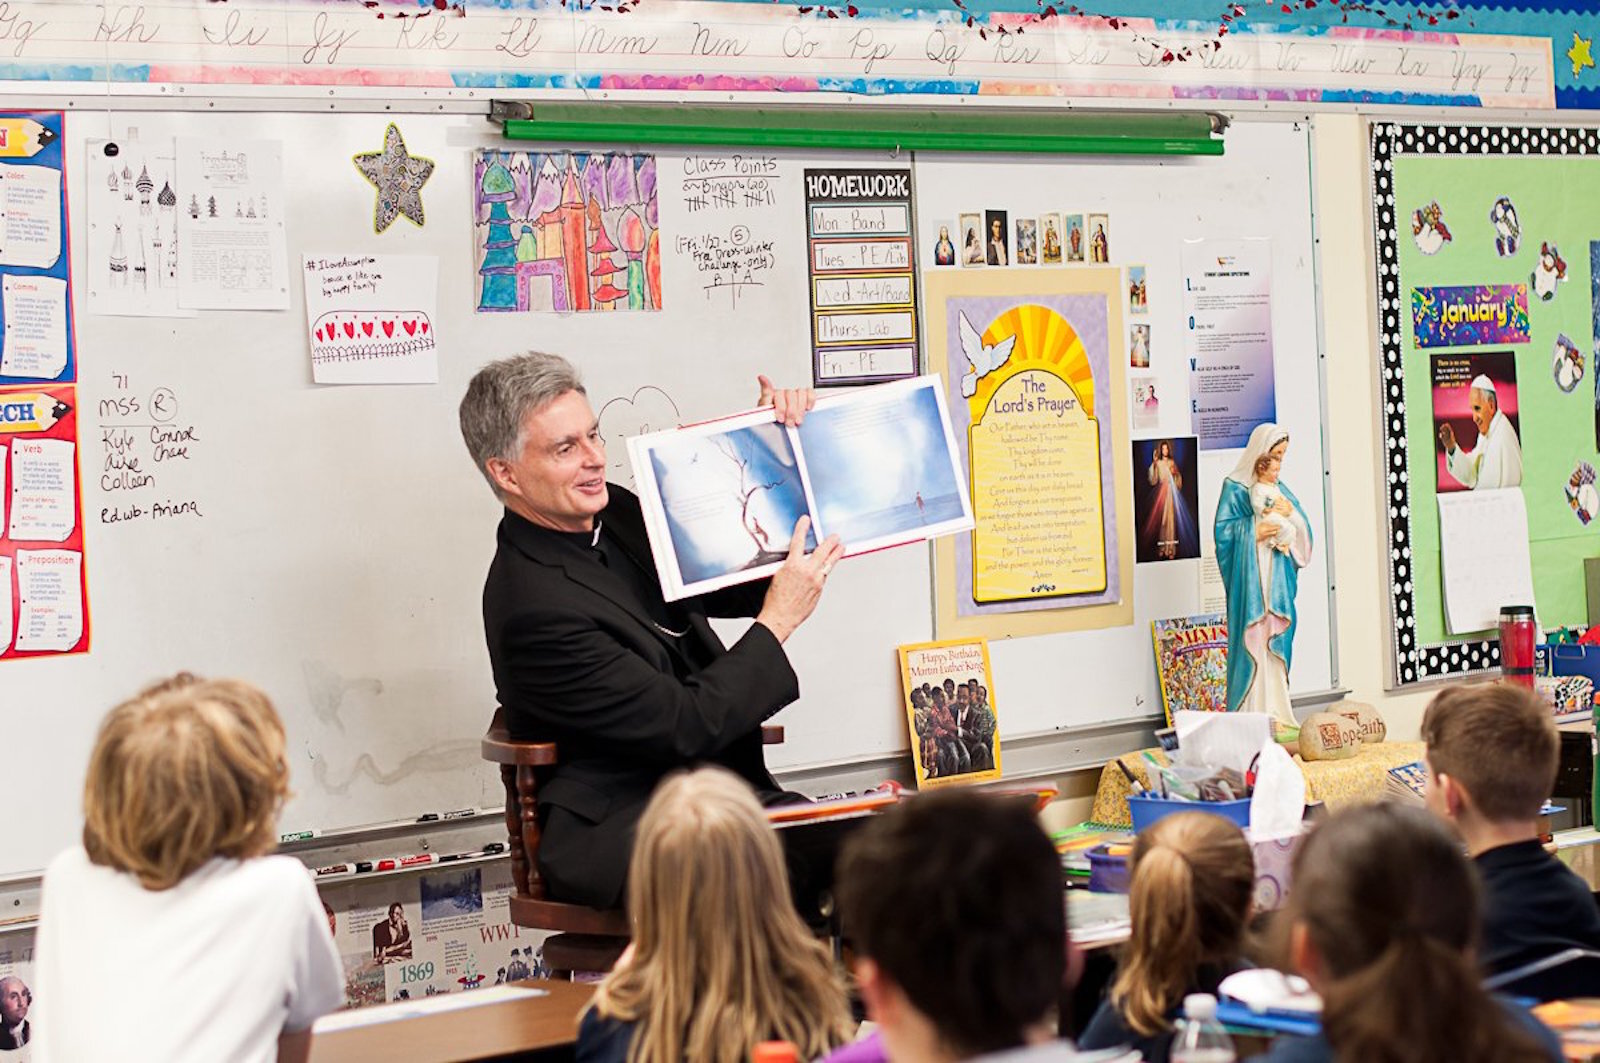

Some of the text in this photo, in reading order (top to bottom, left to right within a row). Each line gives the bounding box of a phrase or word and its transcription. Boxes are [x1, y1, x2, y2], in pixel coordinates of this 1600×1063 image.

[684, 155, 777, 175] Class Points
[806, 174, 909, 198] HOMEWORK
[851, 209, 886, 231] Band
[1440, 299, 1508, 327] January
[868, 319, 890, 336] Lab
[859, 352, 877, 371] PE
[1021, 374, 1046, 393] The
[994, 393, 1077, 418] Lord's Prayer
[23, 445, 42, 454] Verb
[101, 471, 155, 492] Colleen
[28, 555, 74, 566] Preposition
[400, 960, 434, 984] 1869
